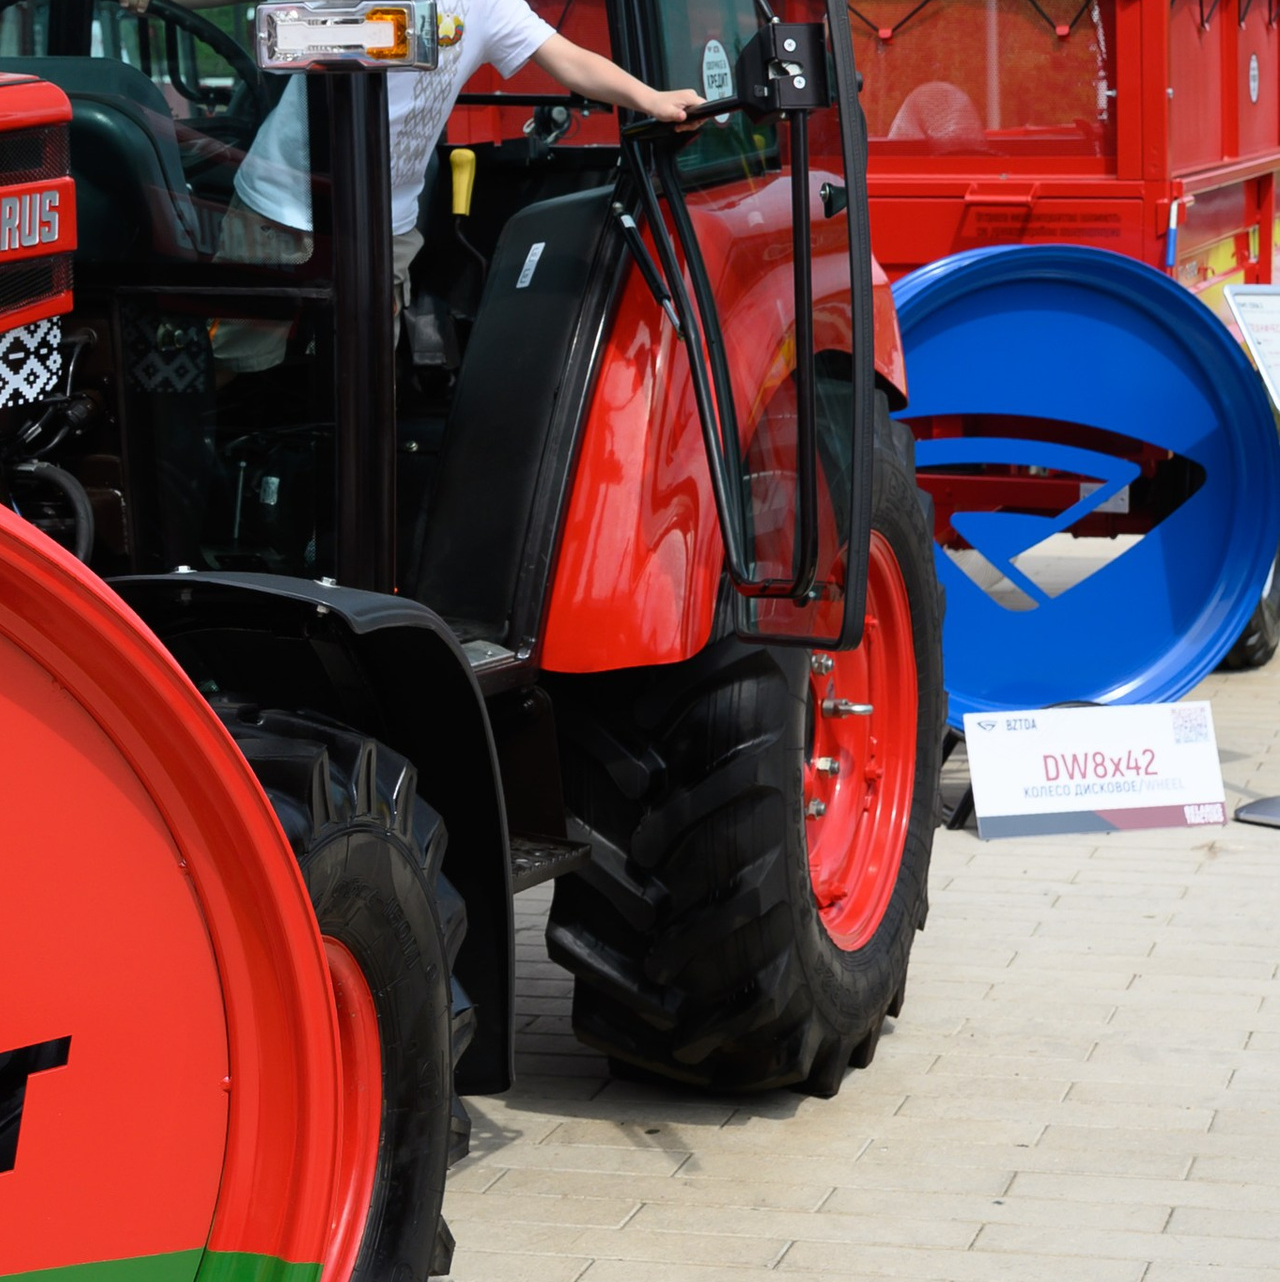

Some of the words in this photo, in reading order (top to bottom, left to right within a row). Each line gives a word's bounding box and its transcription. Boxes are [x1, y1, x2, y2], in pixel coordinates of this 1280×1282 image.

[1006, 719, 1037, 731] BZTDA
[1043, 749, 1158, 782] DW8x42
[1024, 783, 1071, 799] КОЛЕСО
